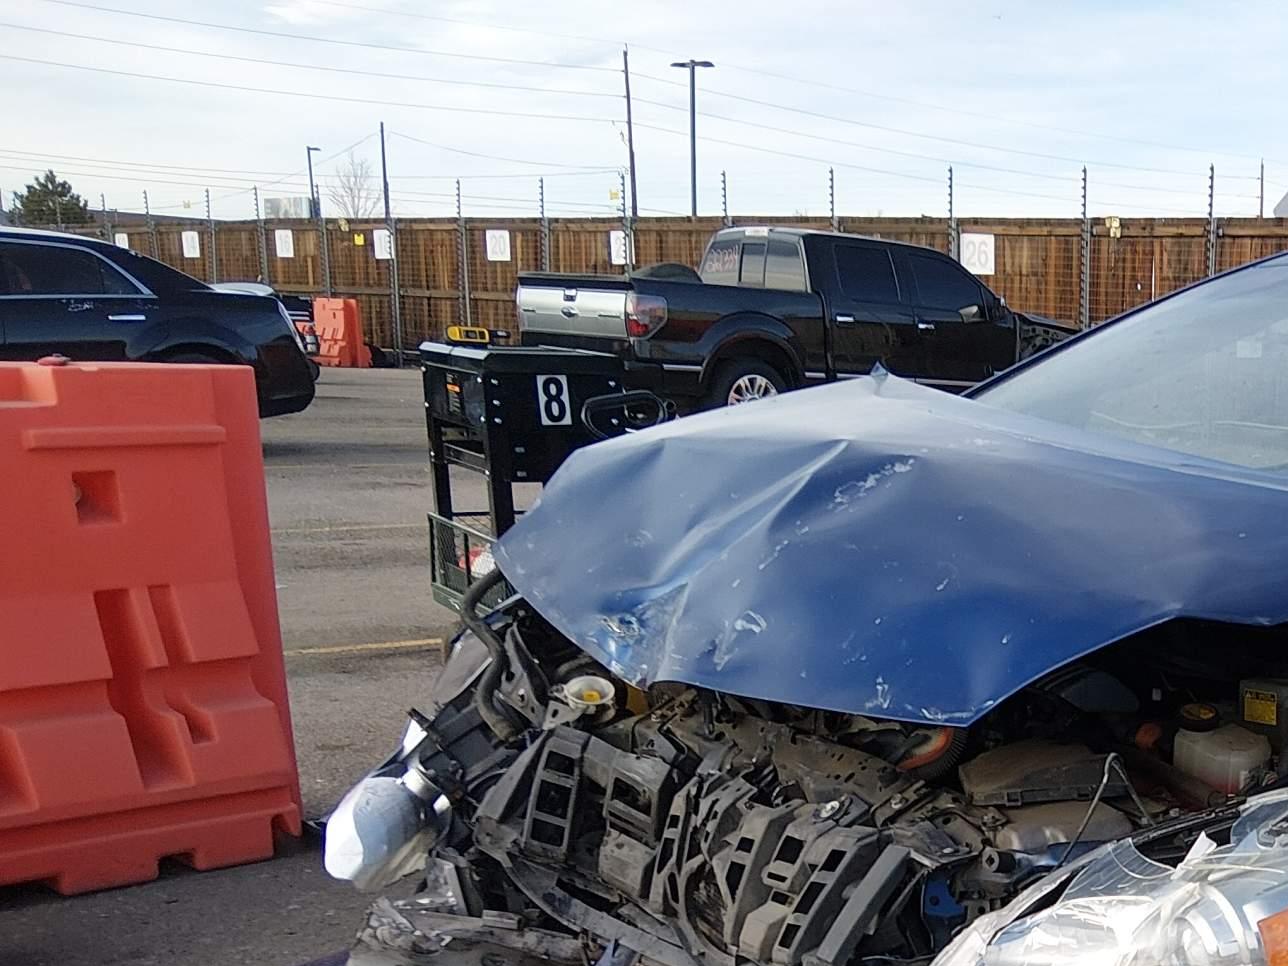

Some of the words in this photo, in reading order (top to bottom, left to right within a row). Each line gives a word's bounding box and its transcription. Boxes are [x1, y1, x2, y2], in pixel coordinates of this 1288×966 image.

[490, 236, 506, 258] 20
[966, 240, 989, 269] 26
[542, 376, 567, 423] 8
